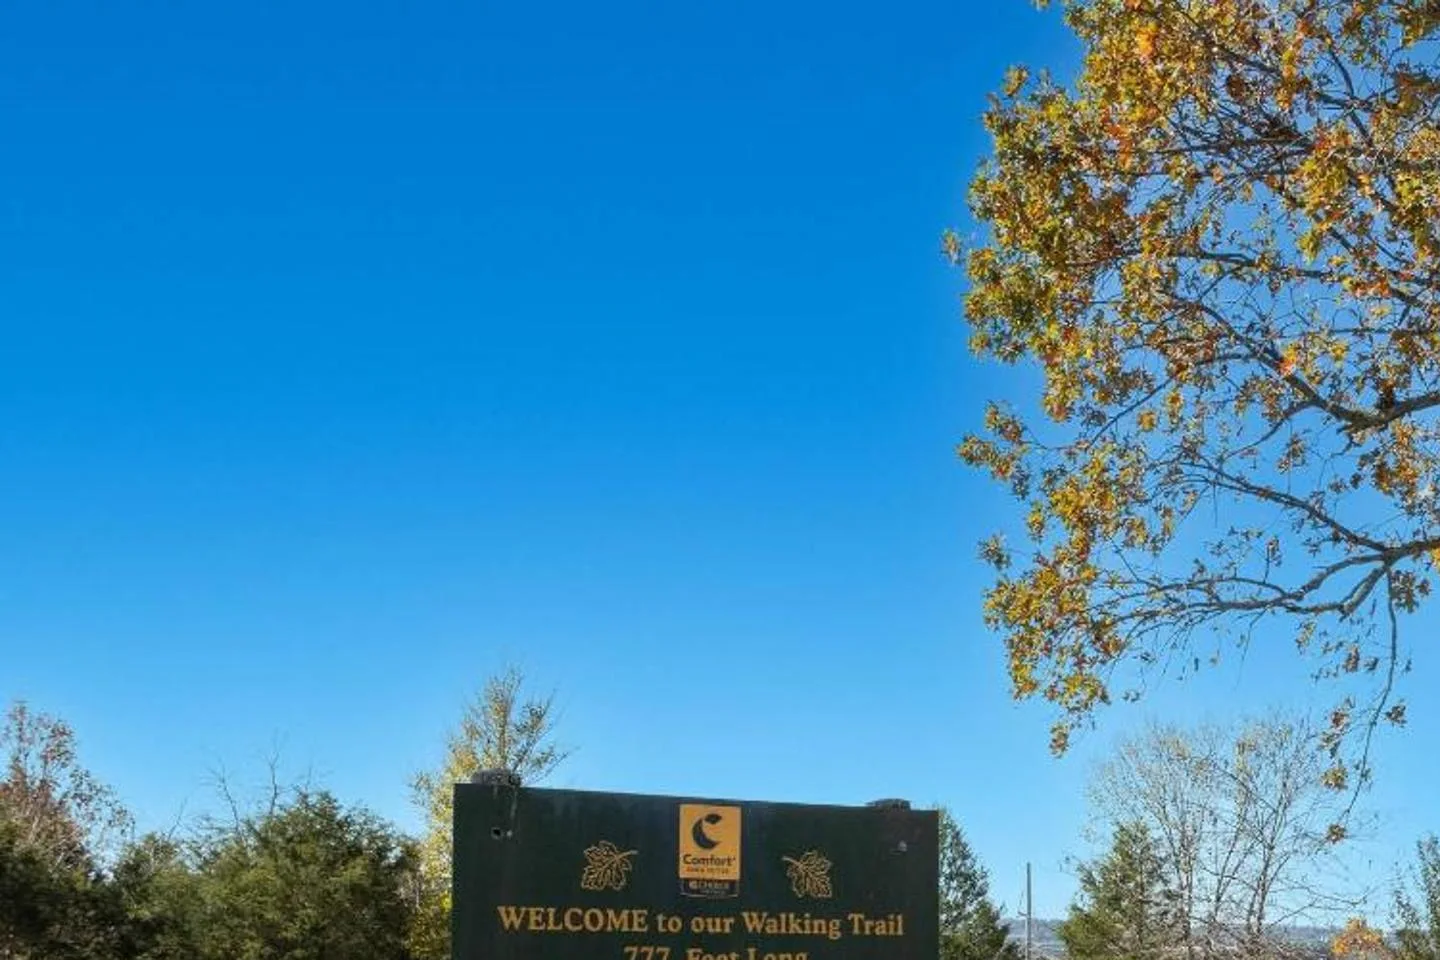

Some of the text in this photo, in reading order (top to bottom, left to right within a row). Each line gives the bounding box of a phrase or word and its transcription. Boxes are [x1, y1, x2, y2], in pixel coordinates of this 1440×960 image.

[683, 854, 733, 867] Comfort
[498, 906, 904, 940] WELCOME to our Walking Trail
